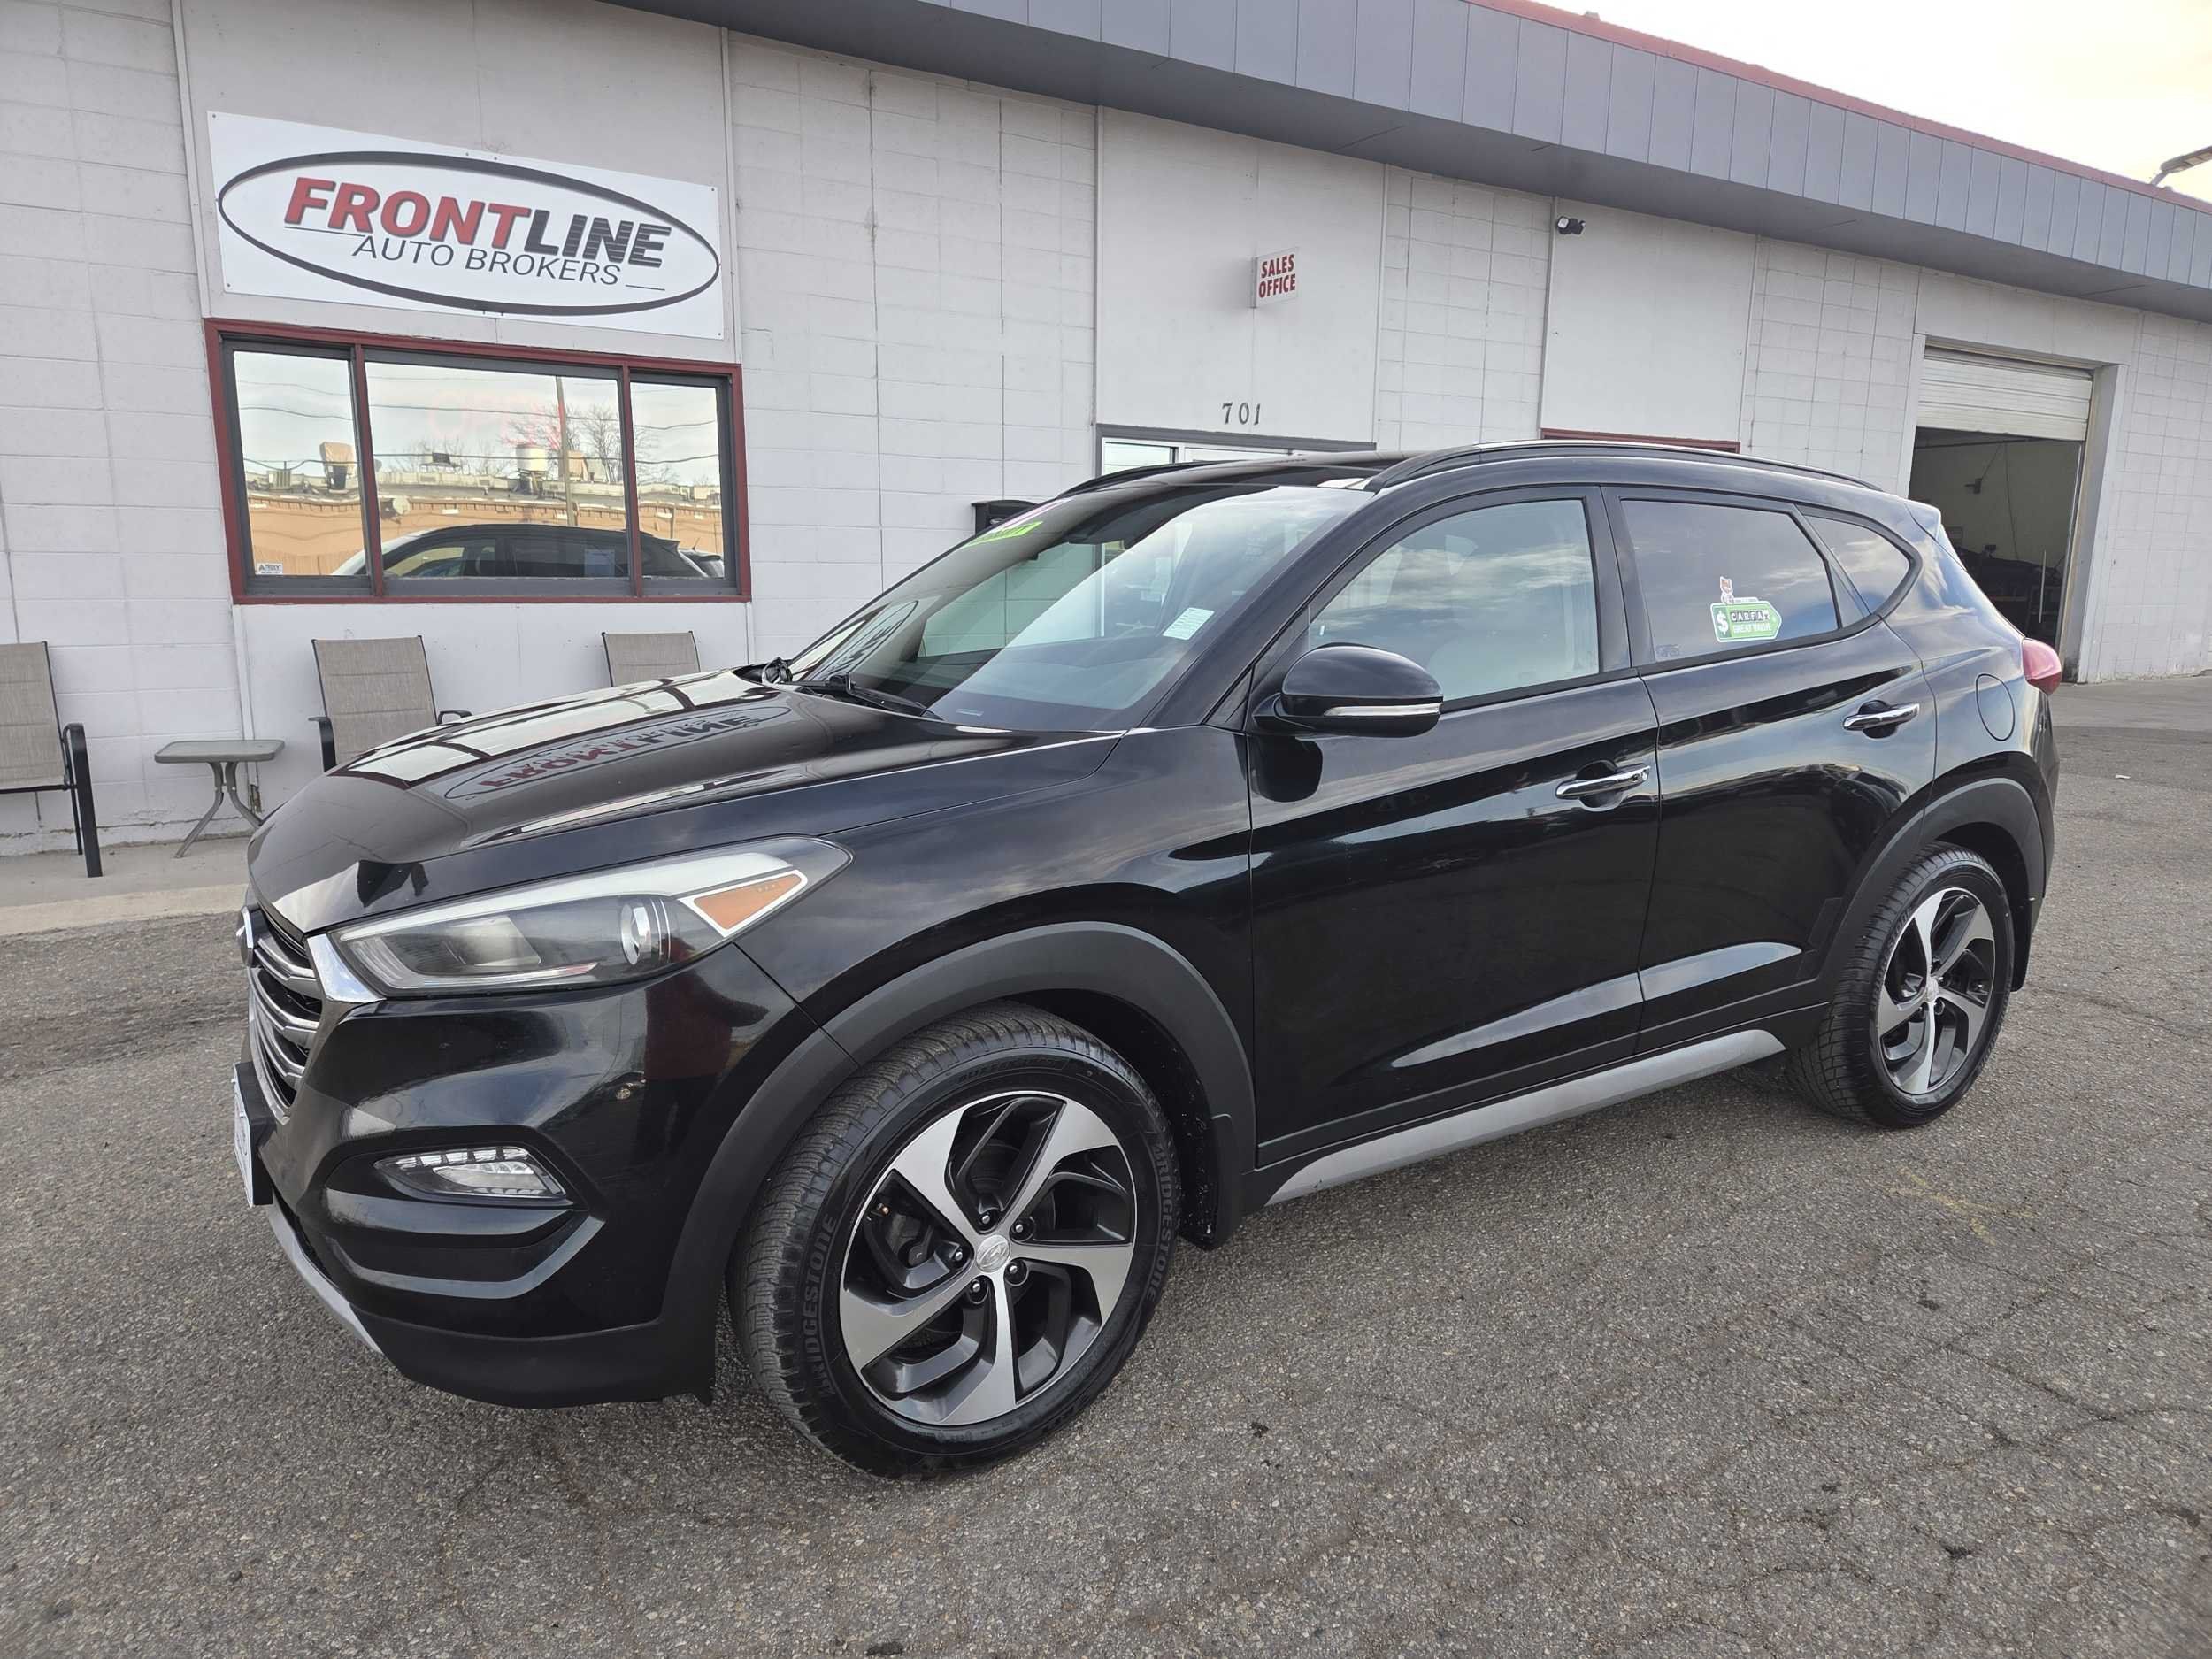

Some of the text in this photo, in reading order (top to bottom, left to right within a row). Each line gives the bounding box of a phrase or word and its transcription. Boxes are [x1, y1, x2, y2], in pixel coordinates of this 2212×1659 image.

[284, 176, 672, 268] FRONTLINE
[351, 235, 622, 286] AUTO BROKERS
[1261, 254, 1294, 279] SALES
[1258, 273, 1296, 298] OFFICE
[1222, 402, 1260, 425] 701
[803, 1213, 838, 1395] BRIDGESTONE
